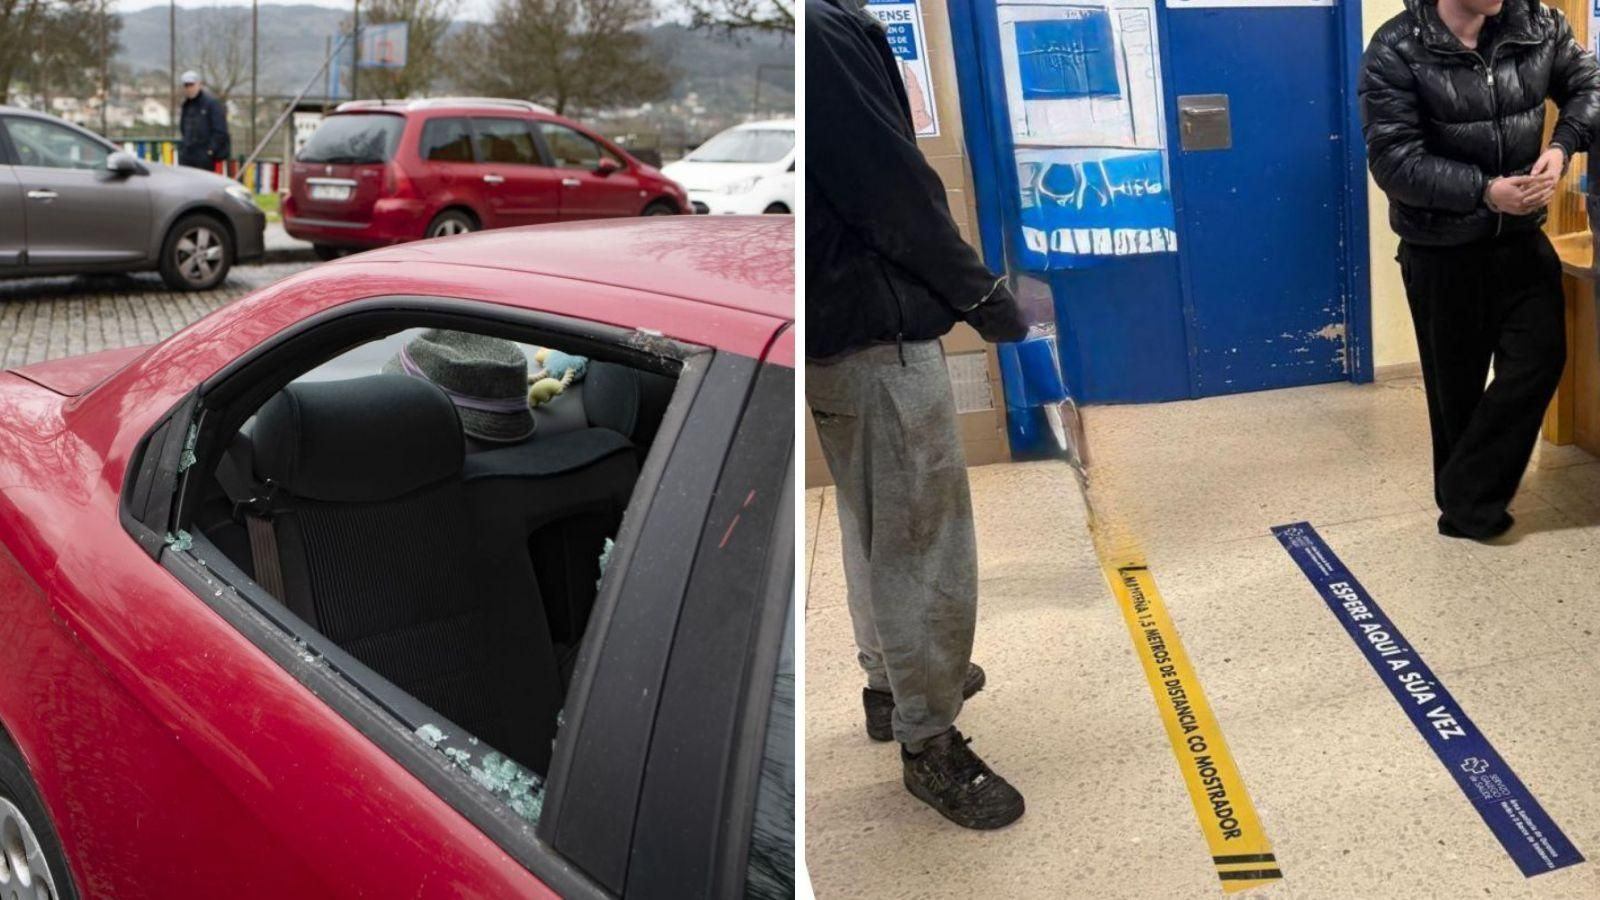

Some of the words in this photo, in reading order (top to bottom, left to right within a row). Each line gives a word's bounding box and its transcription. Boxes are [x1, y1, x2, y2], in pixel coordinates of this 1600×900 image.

[875, 9, 912, 21] ENSE
[1145, 628, 1171, 664] METROS
[1328, 581, 1373, 621] ESPERE
[1358, 623, 1409, 657] AQUÍ
[1386, 659, 1410, 671] A
[1398, 671, 1435, 705] SÚA
[1426, 705, 1466, 740] VEZ
[1159, 664, 1177, 678] DE
[1164, 679, 1199, 734] DISTANCIA
[1187, 735, 1207, 753] CO
[1194, 755, 1242, 841] MOSTRADOR
